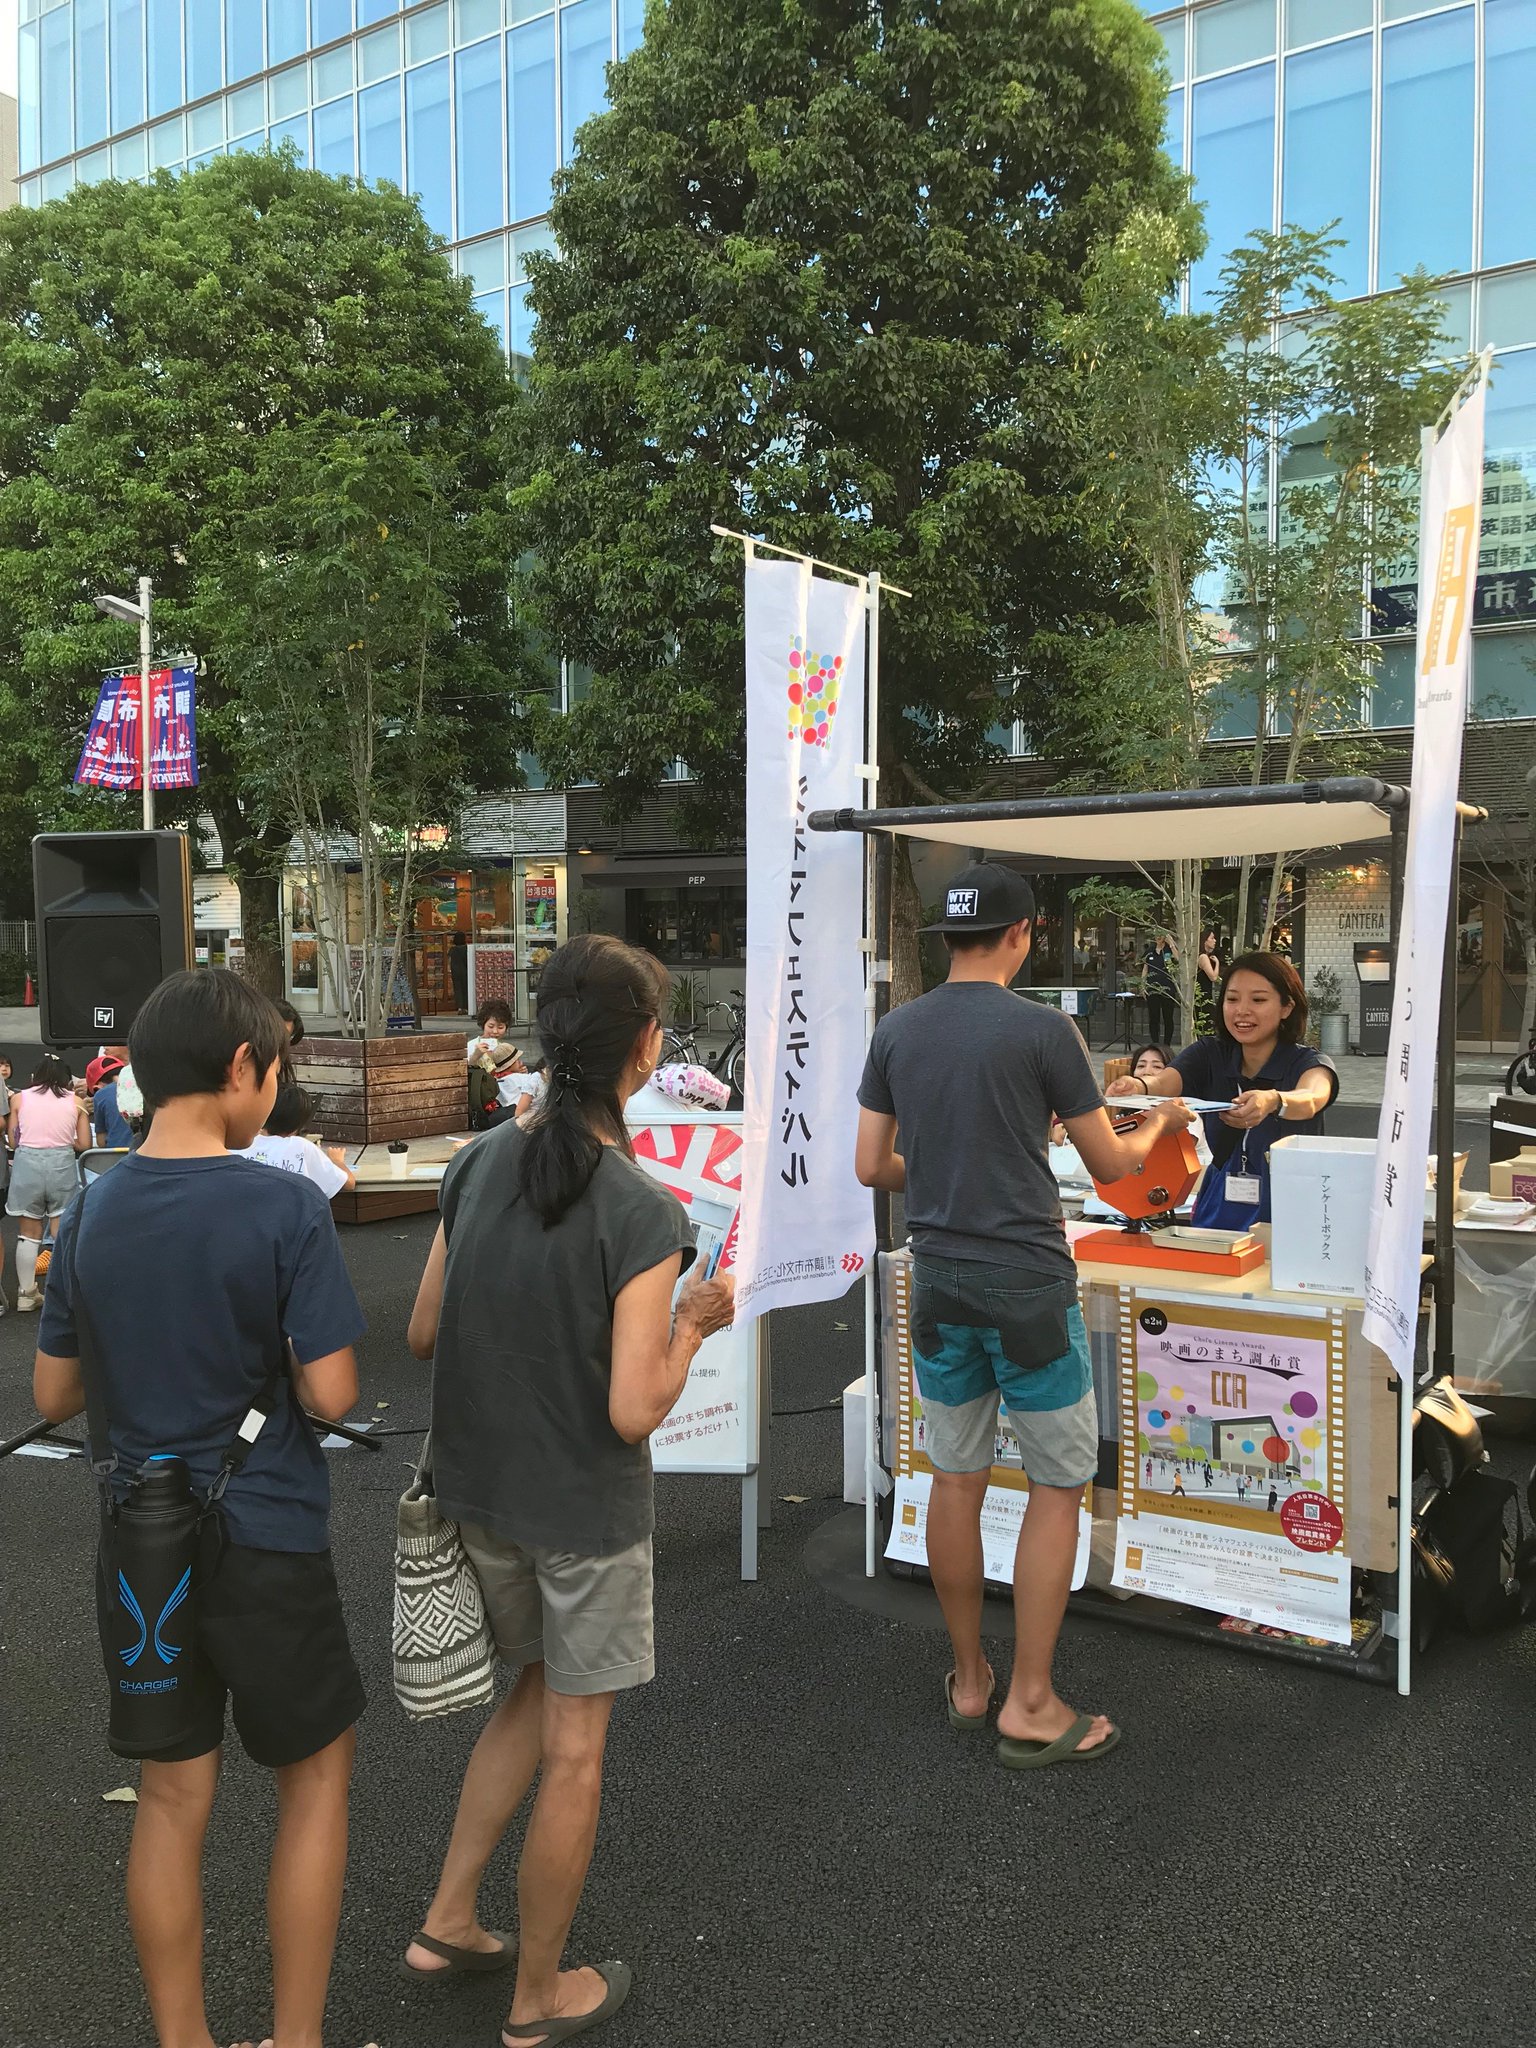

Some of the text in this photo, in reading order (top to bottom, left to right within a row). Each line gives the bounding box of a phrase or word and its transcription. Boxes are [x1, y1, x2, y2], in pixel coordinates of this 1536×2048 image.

[688, 876, 706, 885] PEP
[949, 892, 974, 903] WTF
[949, 903, 970, 914] BKK
[1338, 912, 1385, 930] CANTERA
[1366, 1012, 1390, 1023] CANTER
[1321, 1175, 1332, 1261] アンケートボックス
[1193, 1335, 1213, 1344] Chofu
[1160, 1340, 1302, 1371] 映画のまち調布賞
[1211, 1370, 1247, 1410] CCA
[119, 1676, 178, 1690] CHARGER
